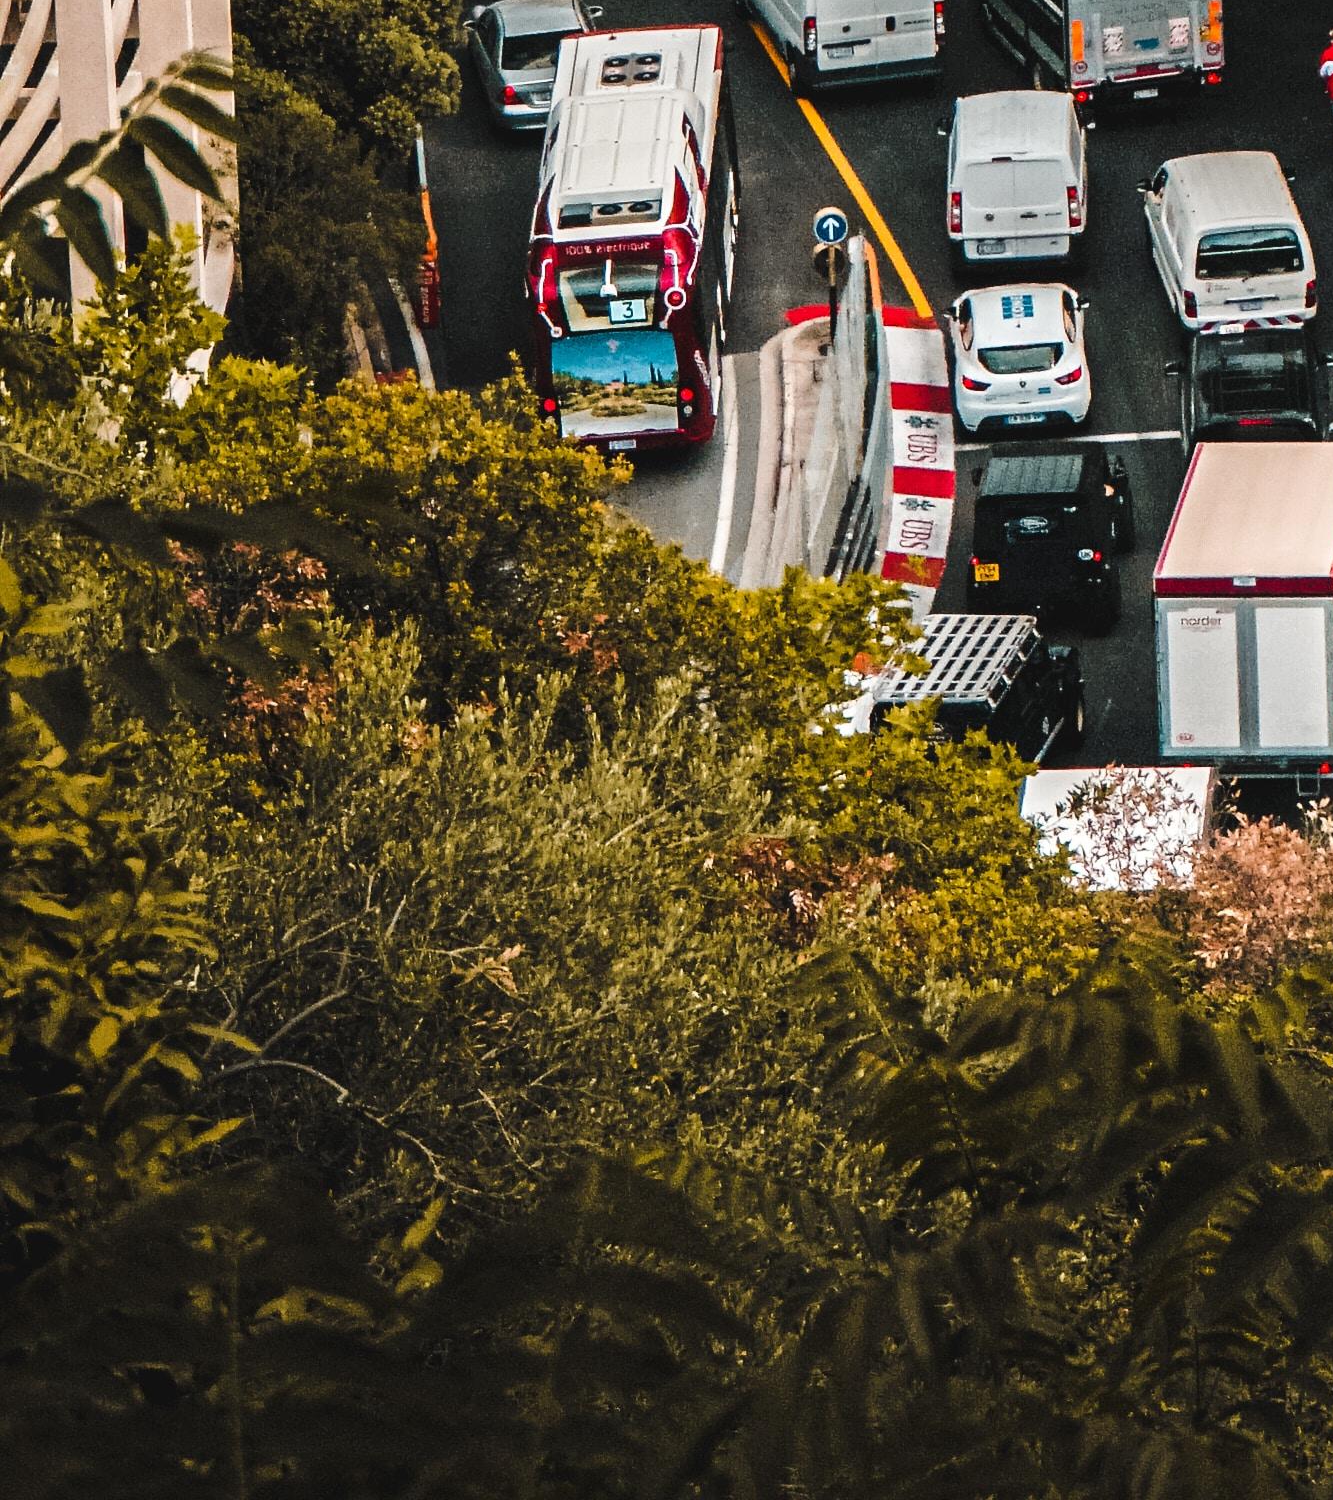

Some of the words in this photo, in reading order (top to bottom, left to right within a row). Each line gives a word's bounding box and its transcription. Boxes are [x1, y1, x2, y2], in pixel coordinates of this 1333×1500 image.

[565, 245, 592, 256] 100%
[622, 301, 634, 319] 3
[907, 432, 938, 465] UBS
[900, 518, 935, 551] UBS
